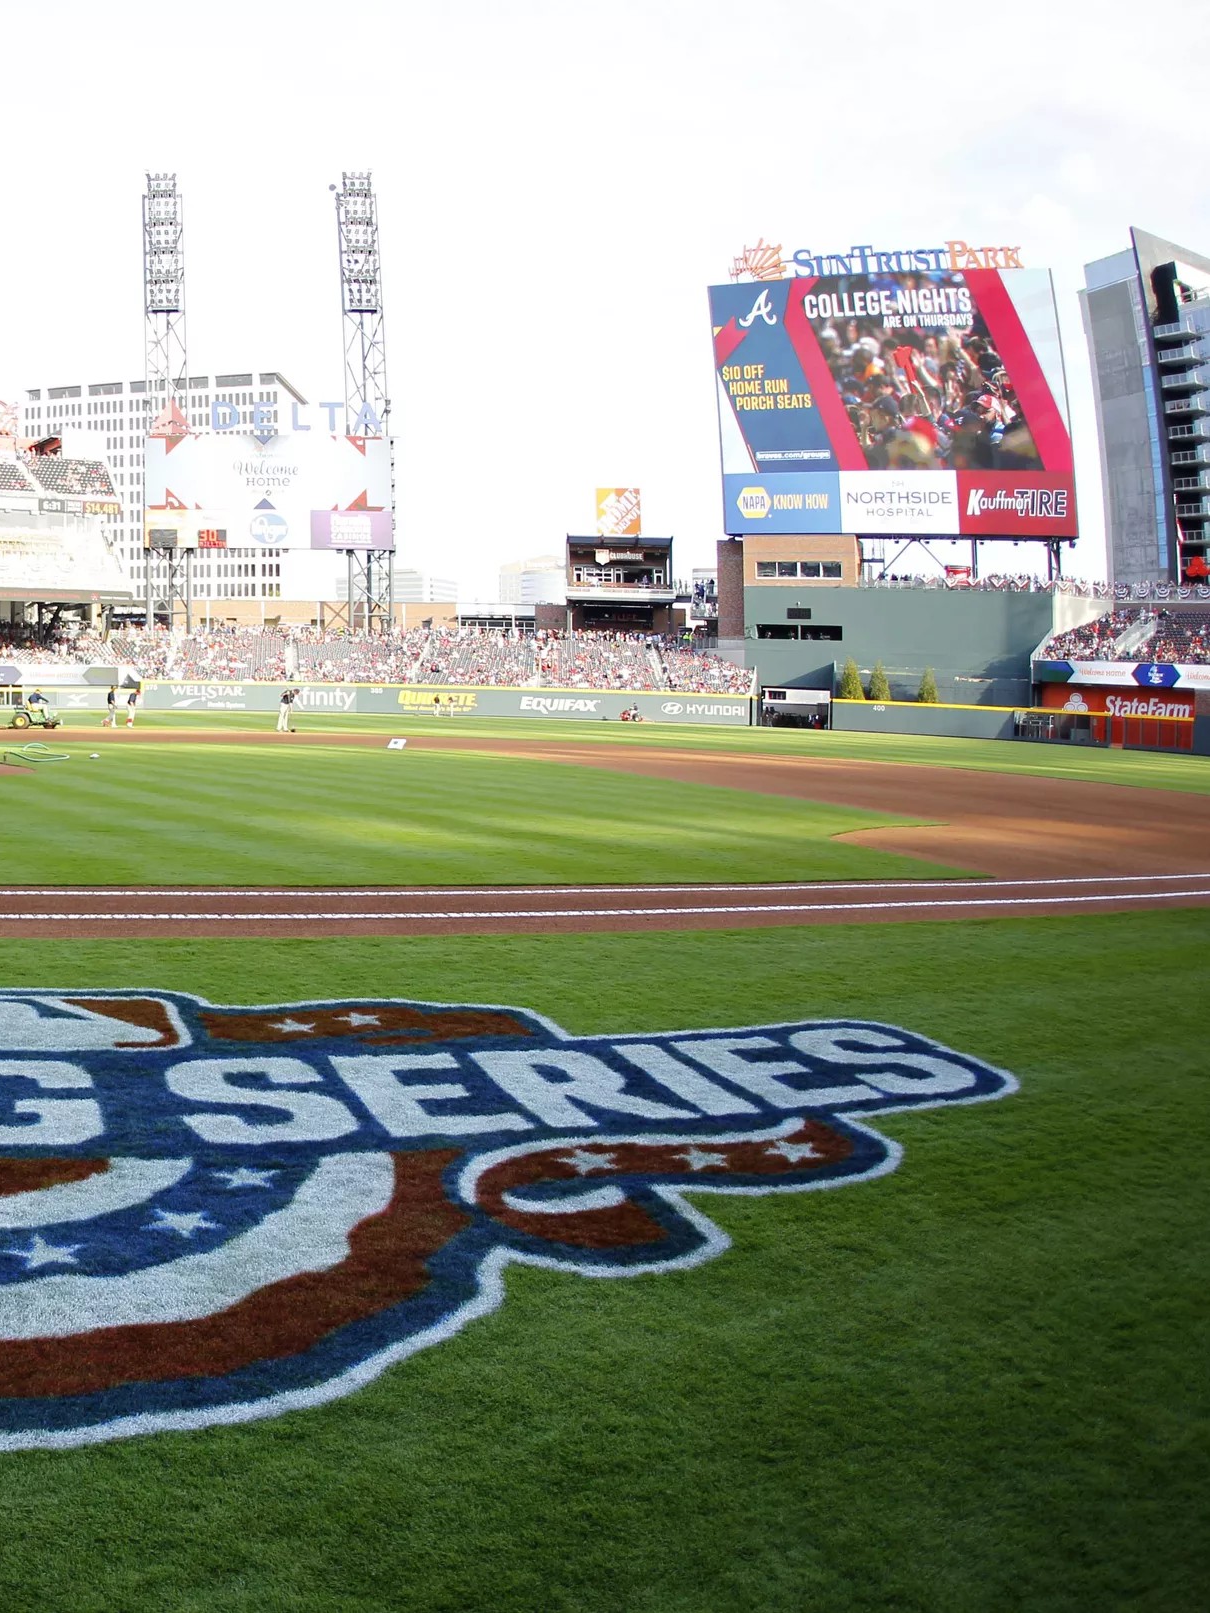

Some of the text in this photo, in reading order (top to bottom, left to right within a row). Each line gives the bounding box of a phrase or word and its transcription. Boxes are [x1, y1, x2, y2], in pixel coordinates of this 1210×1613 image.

[803, 287, 972, 320] COLLEGE NIGHTS
[883, 313, 974, 329] ARE ON THURSDAYS
[722, 364, 765, 381] $10 OFF
[729, 378, 788, 396] HOME RUN
[736, 393, 812, 411] PORCH SEATS
[211, 400, 382, 432] DELTA
[233, 460, 299, 476] Welcome
[742, 493, 828, 510] NAPA KNOW HOW
[846, 491, 952, 505] NORTHSIDE
[866, 507, 934, 517] HOSPITAL
[199, 530, 217, 541] 30
[610, 552, 643, 560] CLUBHOUSE
[519, 696, 598, 714] EQUIFAX
[686, 703, 745, 717] HYUNDAI
[164, 1026, 974, 1147] SERIES
